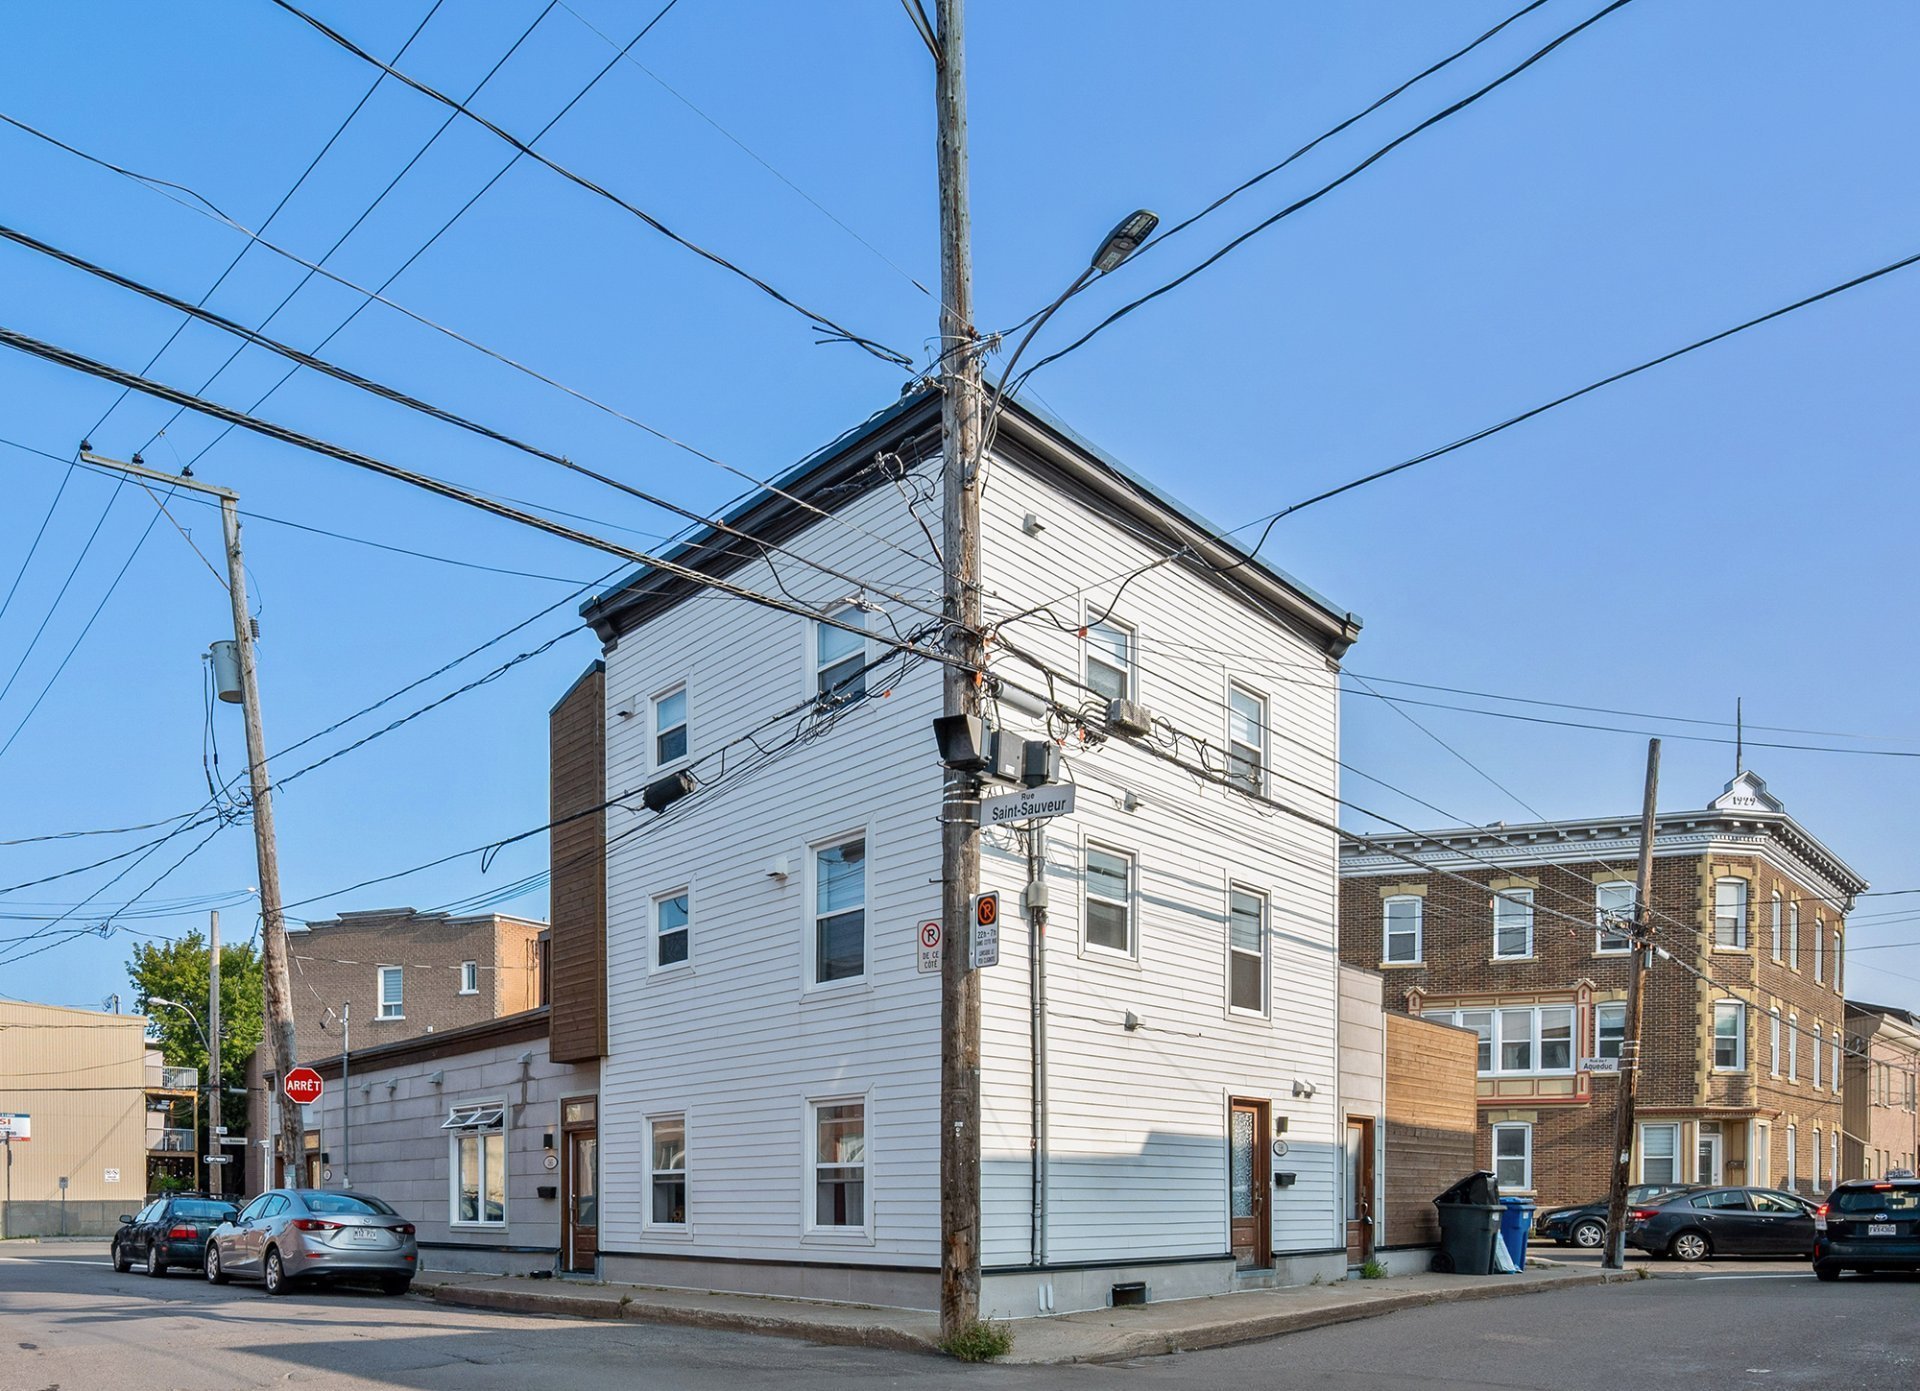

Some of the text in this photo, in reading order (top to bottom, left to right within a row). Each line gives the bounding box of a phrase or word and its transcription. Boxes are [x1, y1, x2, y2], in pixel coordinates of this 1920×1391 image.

[1021, 793, 1035, 801] Rue
[992, 799, 1067, 821] Saint-Sauveur
[922, 951, 939, 960] DE CE
[924, 959, 938, 969] CÔTÉ
[1584, 1062, 1613, 1071] Aqueduc
[287, 1078, 321, 1092] ARRÊT
